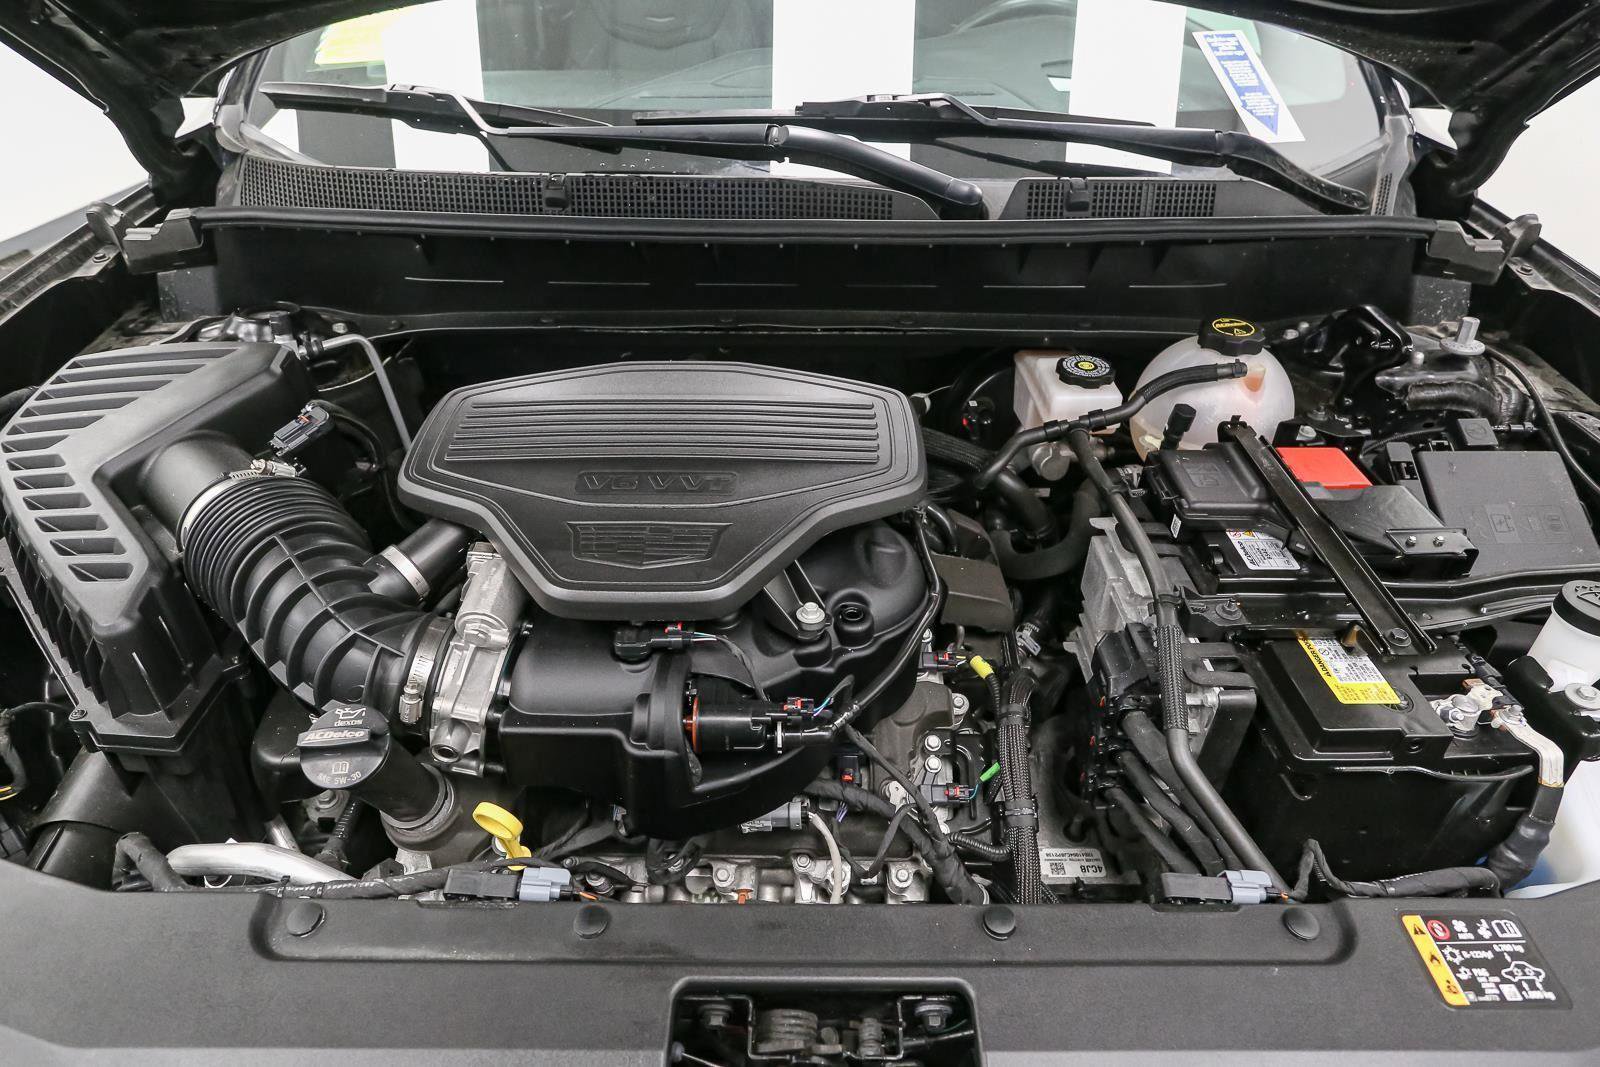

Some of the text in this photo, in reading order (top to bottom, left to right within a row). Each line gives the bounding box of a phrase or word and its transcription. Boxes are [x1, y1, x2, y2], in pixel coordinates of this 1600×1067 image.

[584, 474, 734, 491] V6 VVT
[304, 730, 365, 741] ACDelco
[334, 771, 362, 785] 5W-30
[1079, 865, 1103, 873] 4CJB
